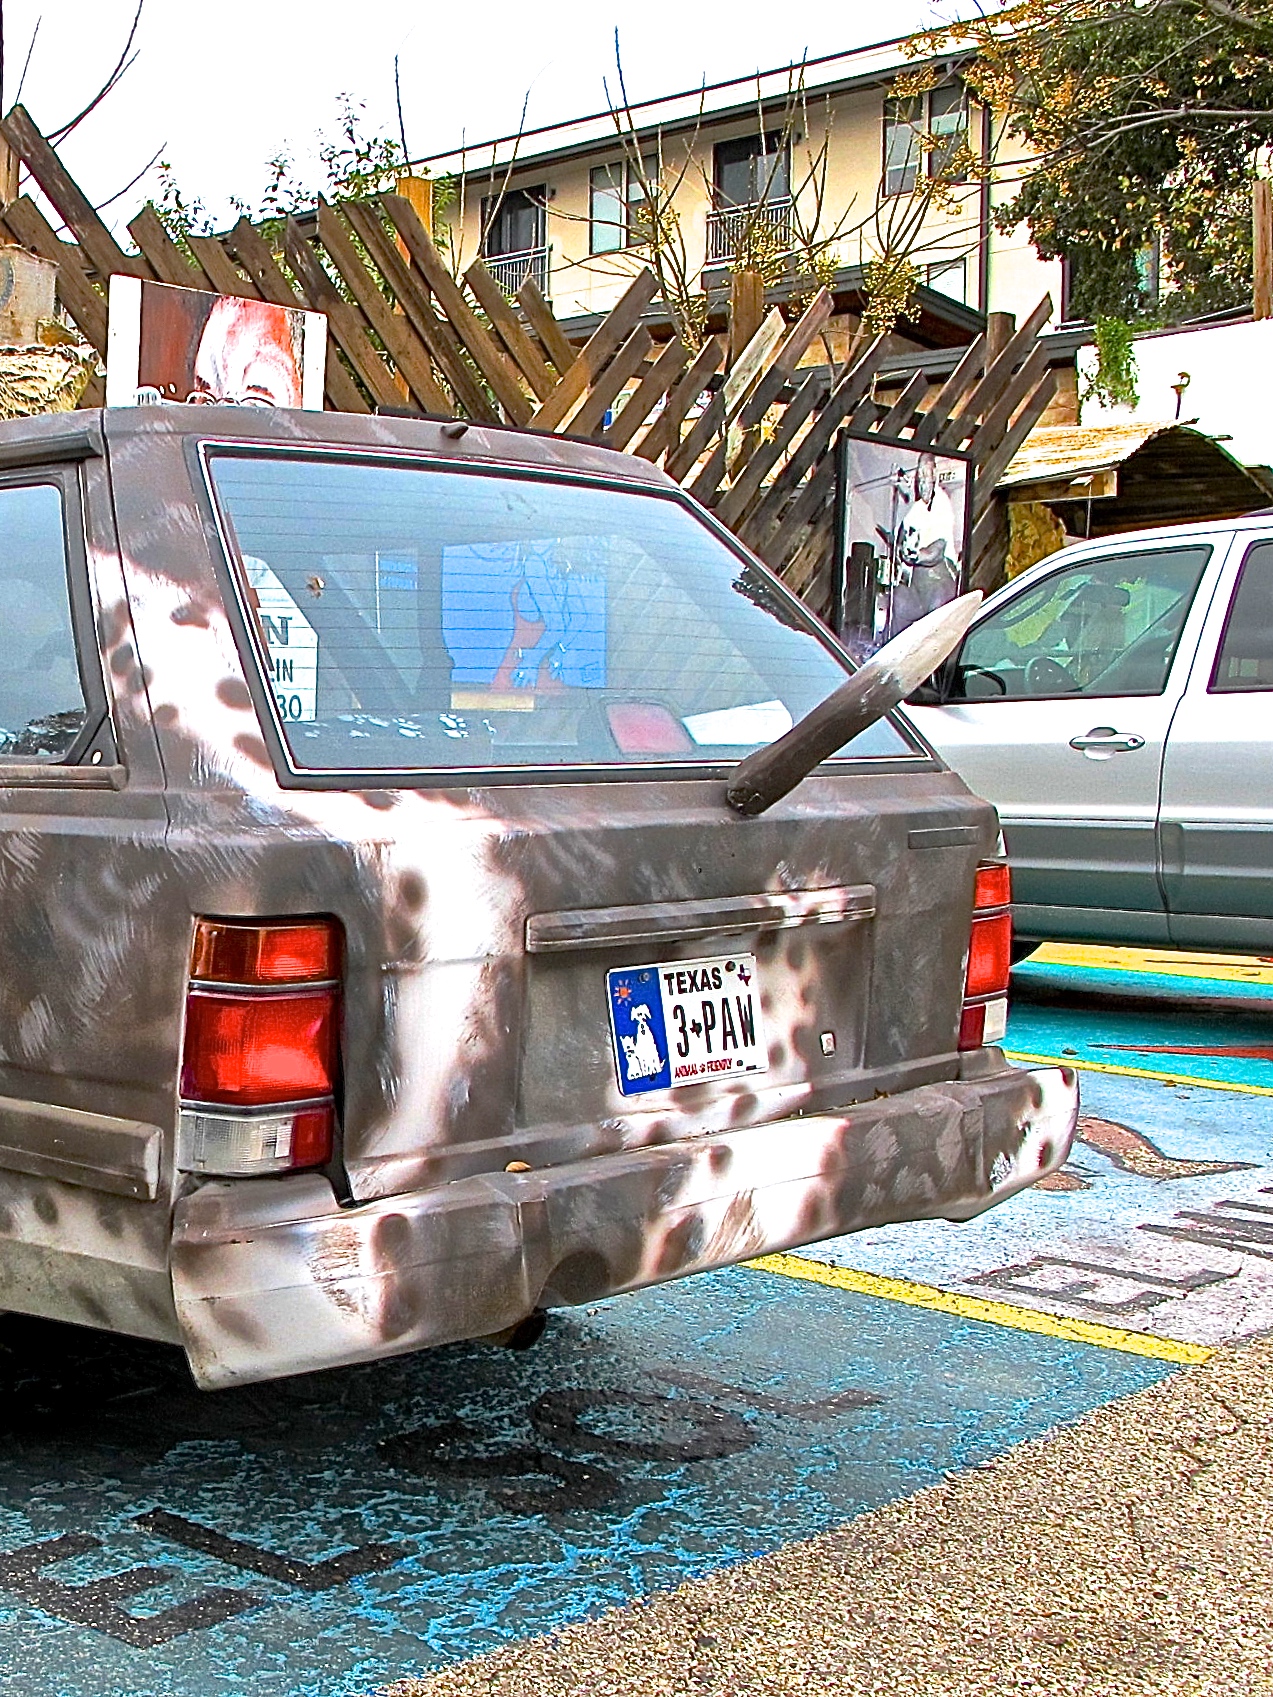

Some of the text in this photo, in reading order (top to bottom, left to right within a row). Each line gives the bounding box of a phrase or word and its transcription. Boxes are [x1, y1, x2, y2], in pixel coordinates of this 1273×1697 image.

[663, 967, 724, 996] TEXAS
[963, 1254, 1242, 1315] EL
[377, 1366, 883, 1514] SOL
